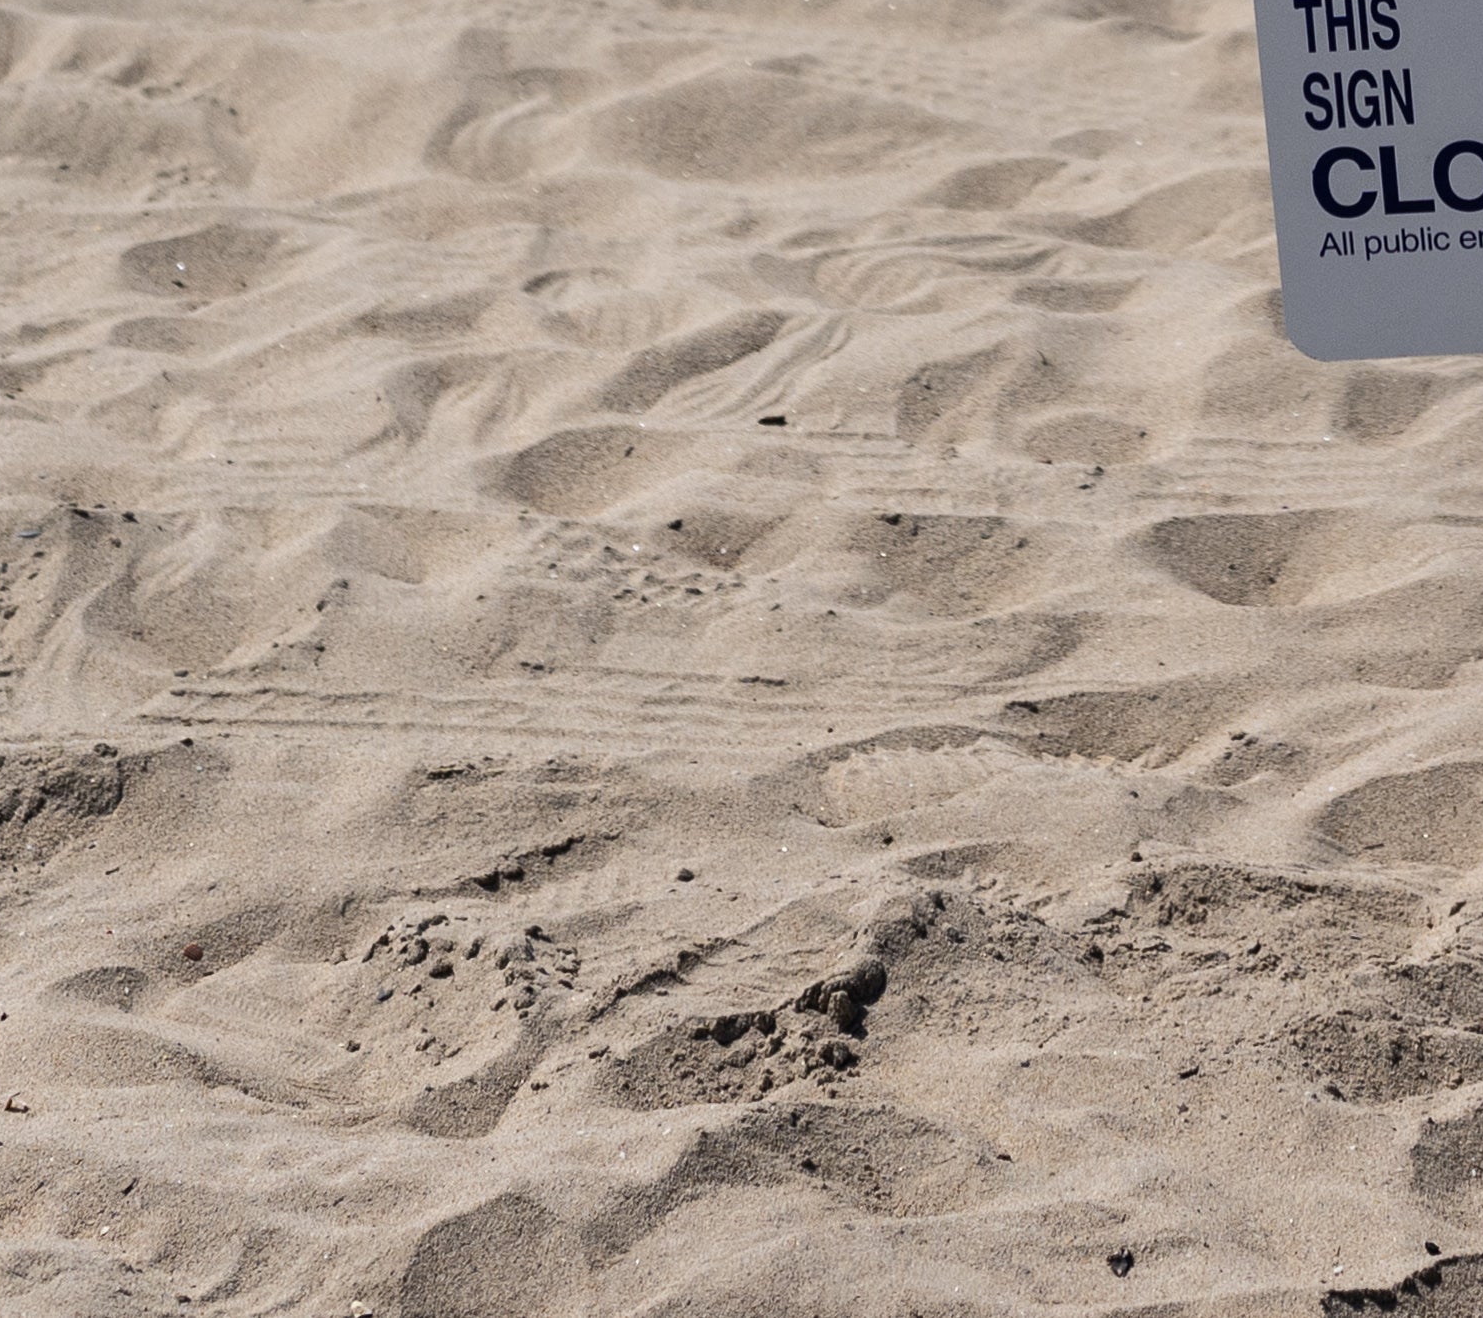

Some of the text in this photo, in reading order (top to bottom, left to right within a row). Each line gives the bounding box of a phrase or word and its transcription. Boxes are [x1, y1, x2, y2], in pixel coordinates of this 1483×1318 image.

[1302, 67, 1415, 131] SIGN
[1319, 231, 1355, 257] All
[1365, 226, 1451, 261] public
